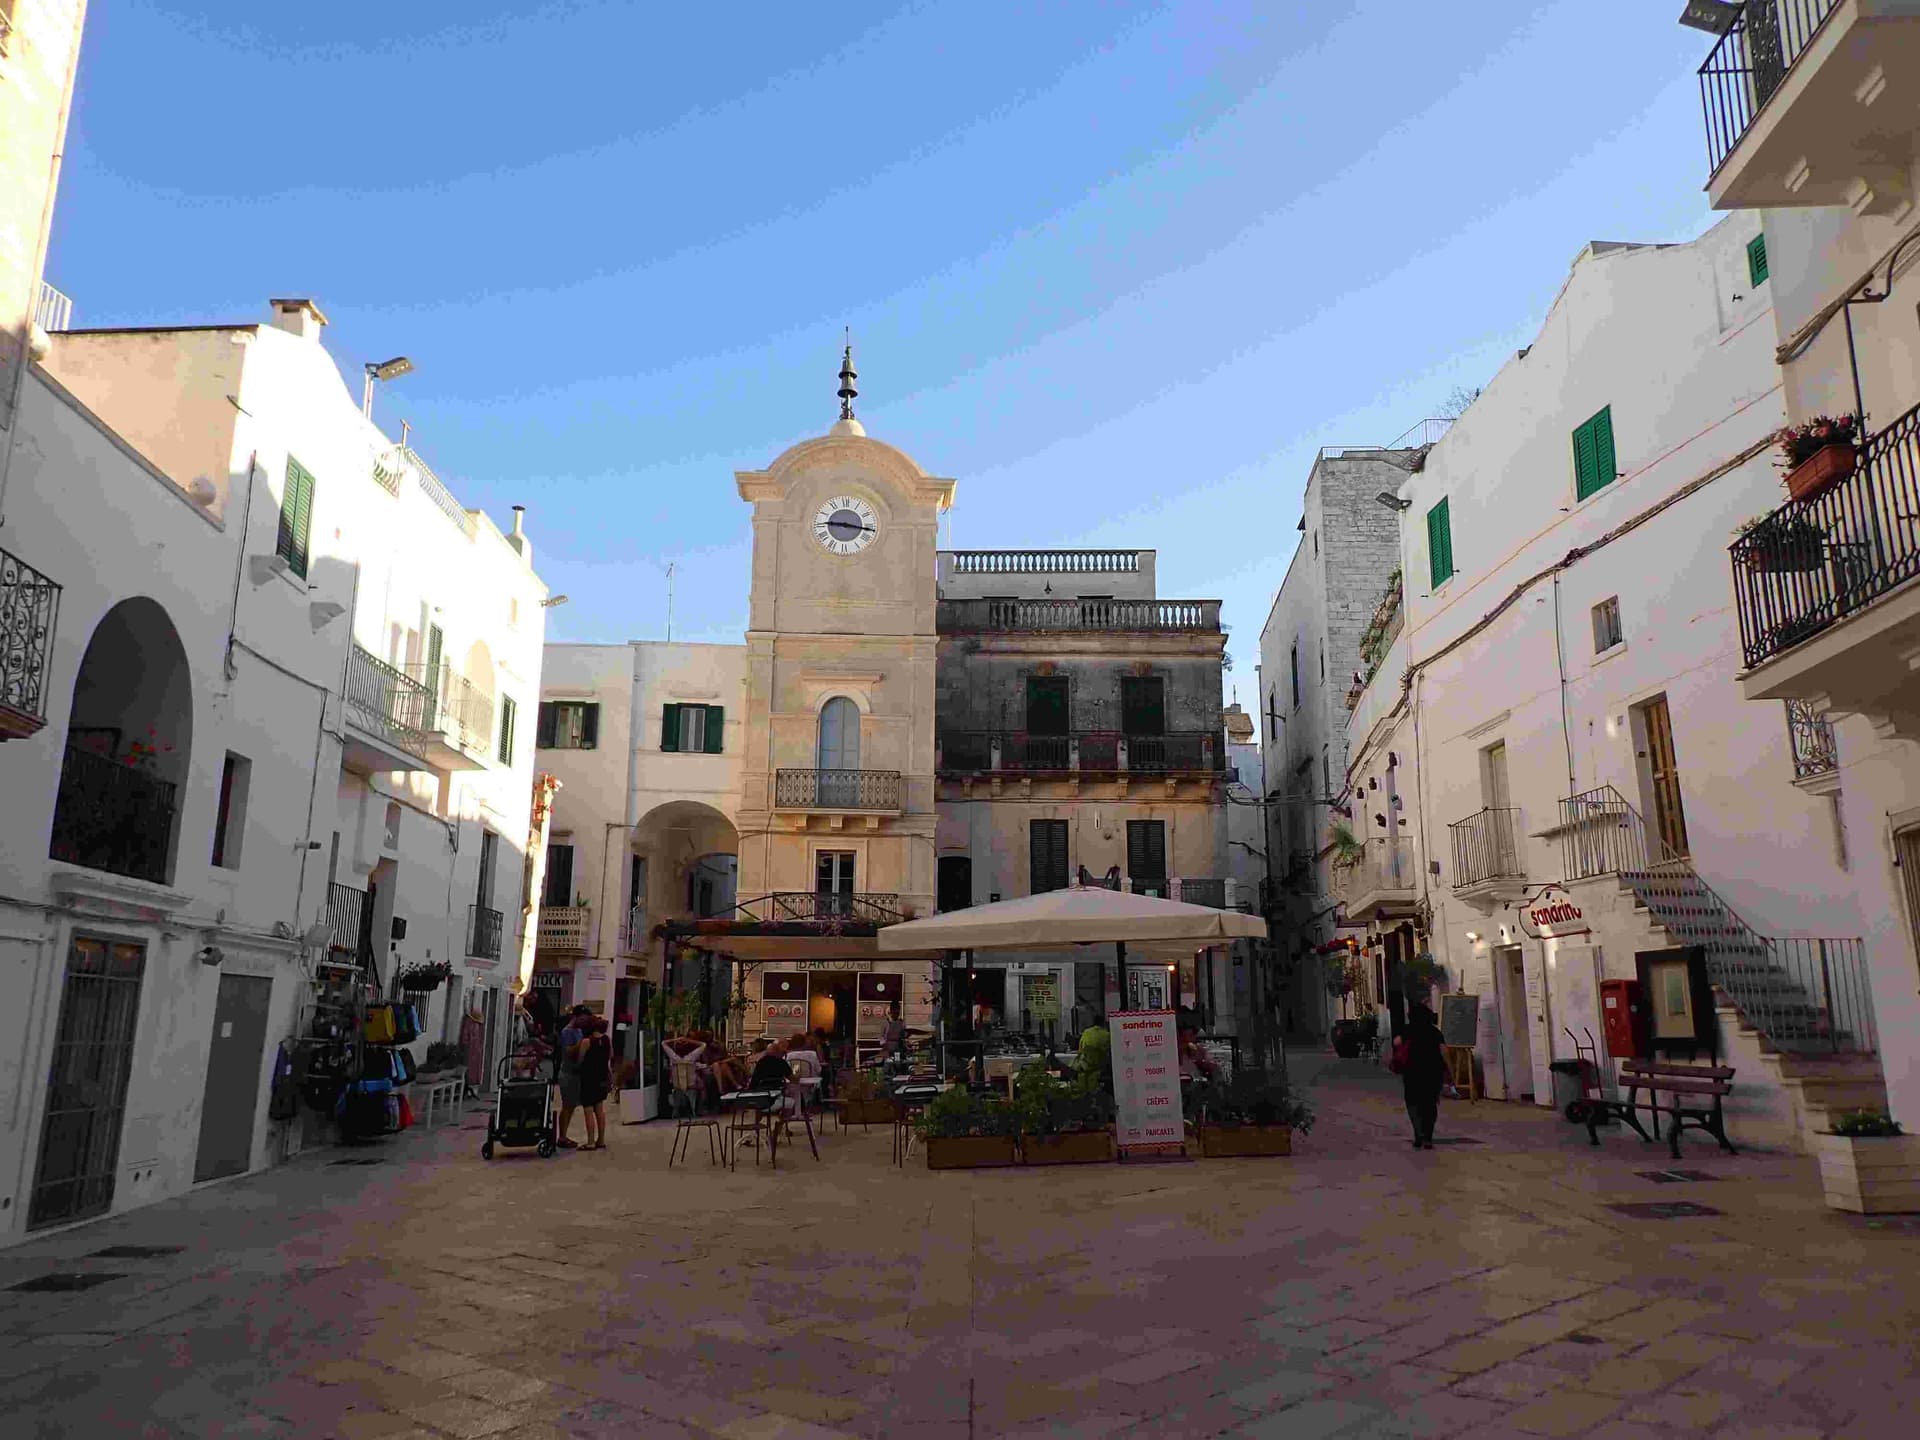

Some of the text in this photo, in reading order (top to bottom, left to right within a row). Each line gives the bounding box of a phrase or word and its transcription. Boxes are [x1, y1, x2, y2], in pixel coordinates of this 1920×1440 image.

[1530, 899, 1582, 927] sandrino
[1145, 1067, 1166, 1076] YOGURT
[1145, 1128, 1175, 1137] PANCAKES
